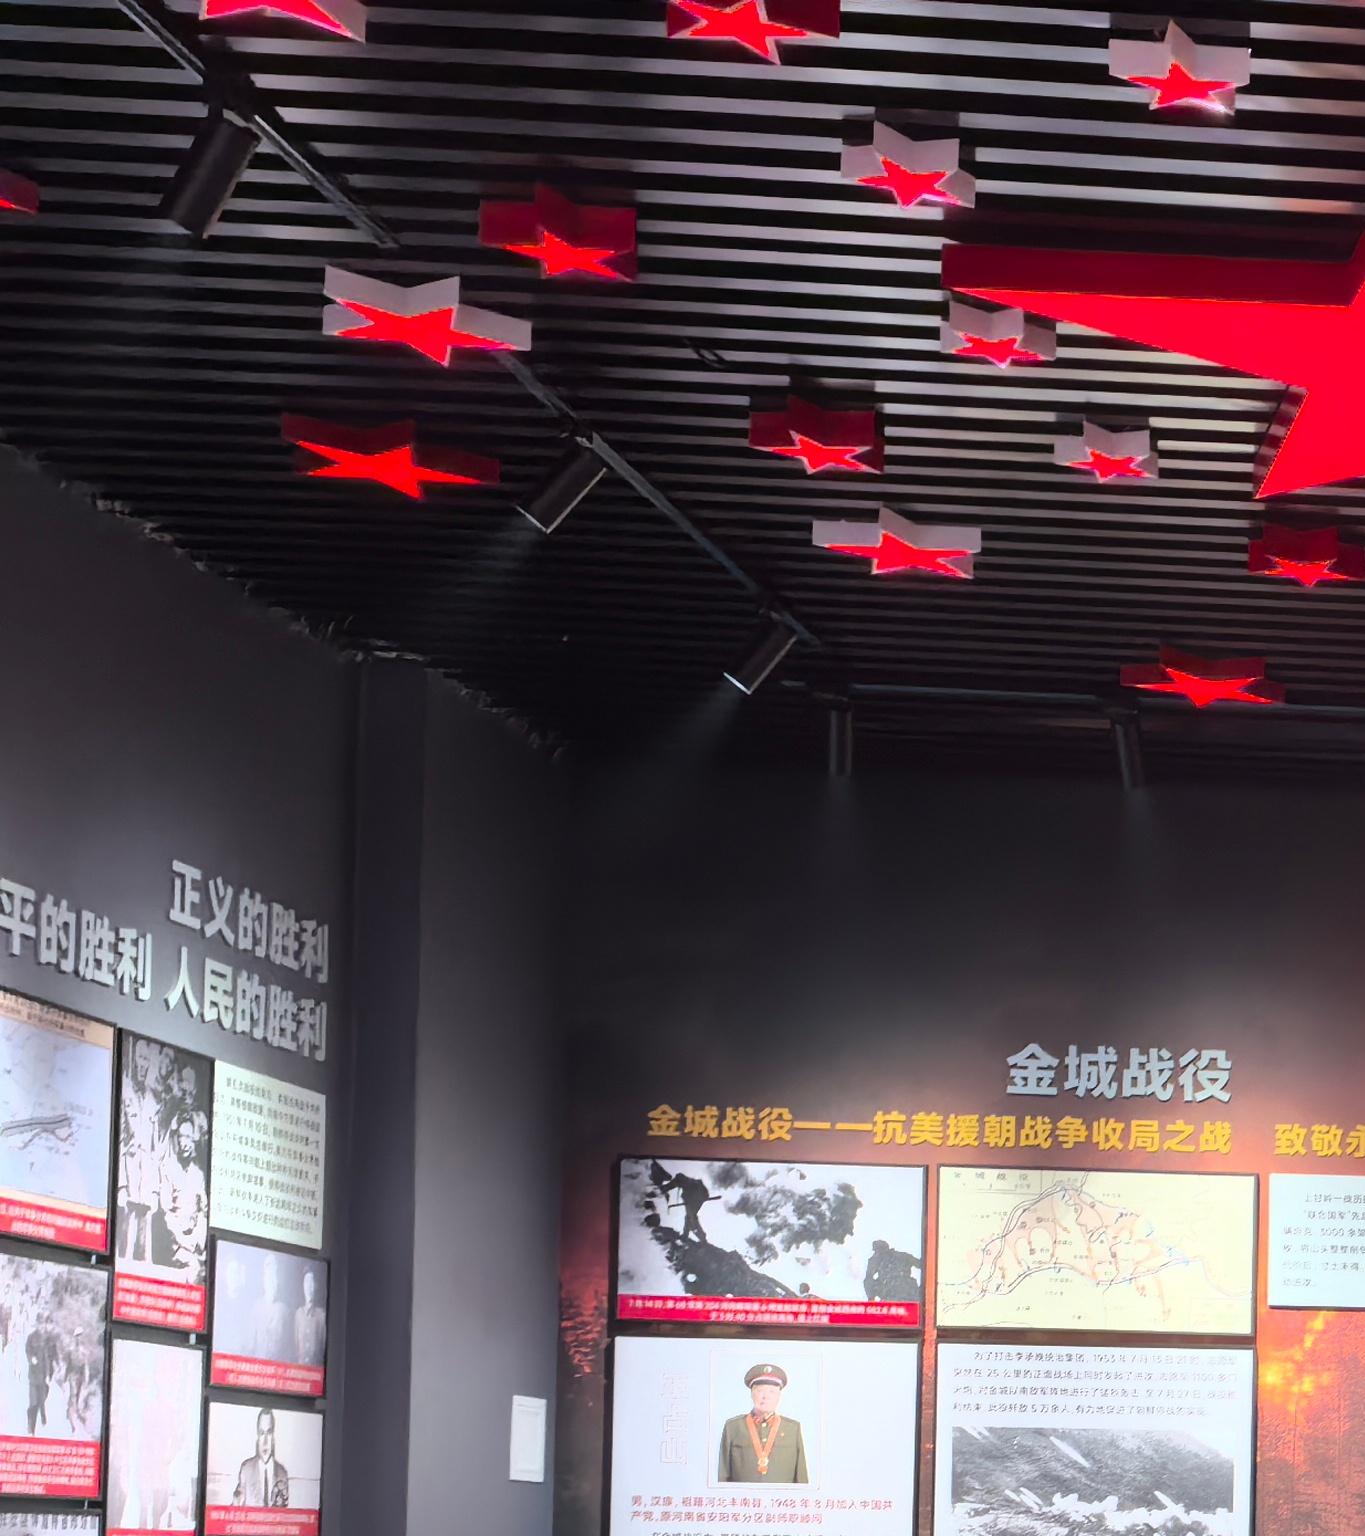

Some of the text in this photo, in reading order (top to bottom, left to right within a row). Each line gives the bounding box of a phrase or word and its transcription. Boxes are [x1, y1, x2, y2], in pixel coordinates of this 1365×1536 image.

[169, 858, 329, 984] 正义的胜利
[165, 945, 327, 1061] 人民的胜利
[1005, 1043, 1233, 1102] 金城战役
[646, 1105, 1232, 1154] 金城战役——抗美援朝战争收局之战
